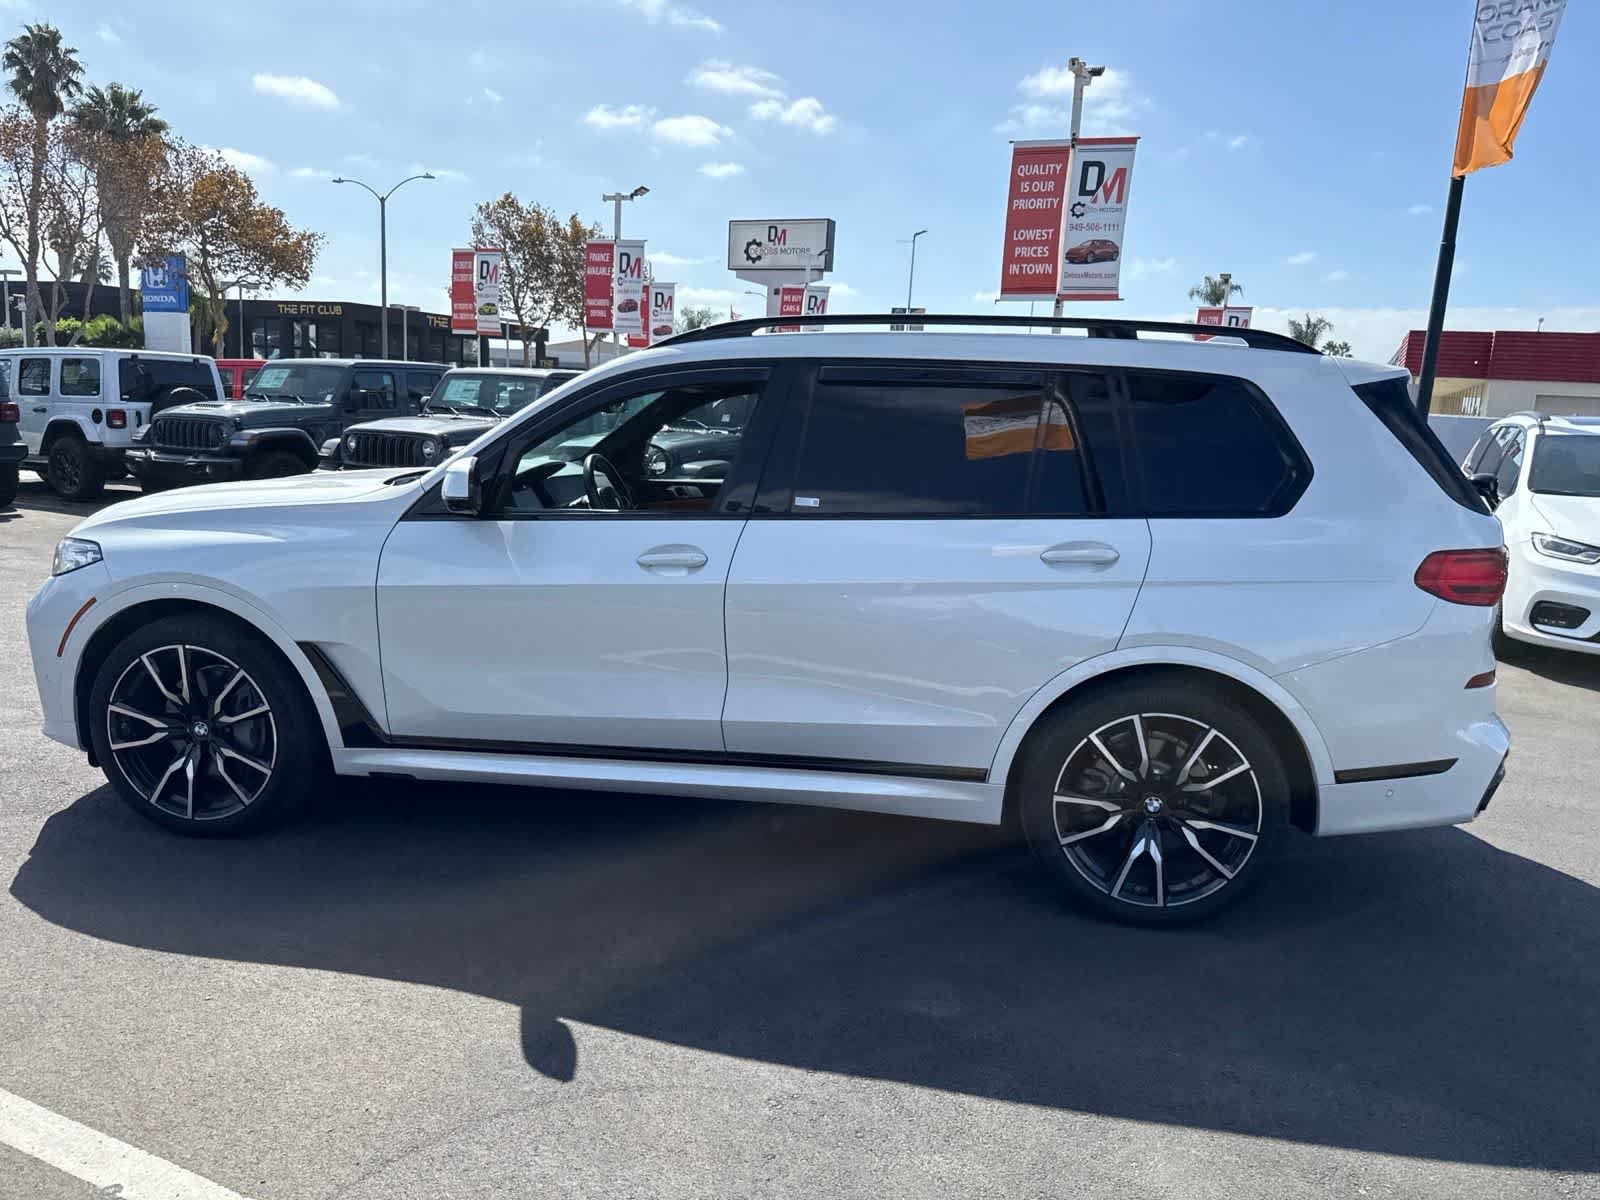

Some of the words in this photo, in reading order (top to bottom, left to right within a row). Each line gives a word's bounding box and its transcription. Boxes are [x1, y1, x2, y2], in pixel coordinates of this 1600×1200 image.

[1017, 163, 1062, 176] QUALITY
[1020, 182, 1031, 192] IS
[1032, 180, 1055, 192] OUR
[1078, 160, 1128, 204] DM
[1012, 198, 1060, 210] PRIORITY
[1068, 222, 1120, 232] 949-506-1111
[767, 225, 788, 246] DM
[1013, 229, 1054, 241] LOWEST
[779, 247, 811, 256] MOTORS
[1014, 246, 1049, 257] PRICES
[480, 260, 498, 284] DM
[619, 252, 642, 279] DM
[1009, 264, 1020, 275] IN
[1021, 263, 1053, 275] TOWN
[143, 295, 177, 304] HONDA
[654, 292, 673, 311] DM
[807, 295, 826, 315] DM
[277, 303, 298, 315] THE
[300, 303, 316, 315] FIT
[317, 304, 343, 316] CLUB
[426, 315, 449, 328] THE
